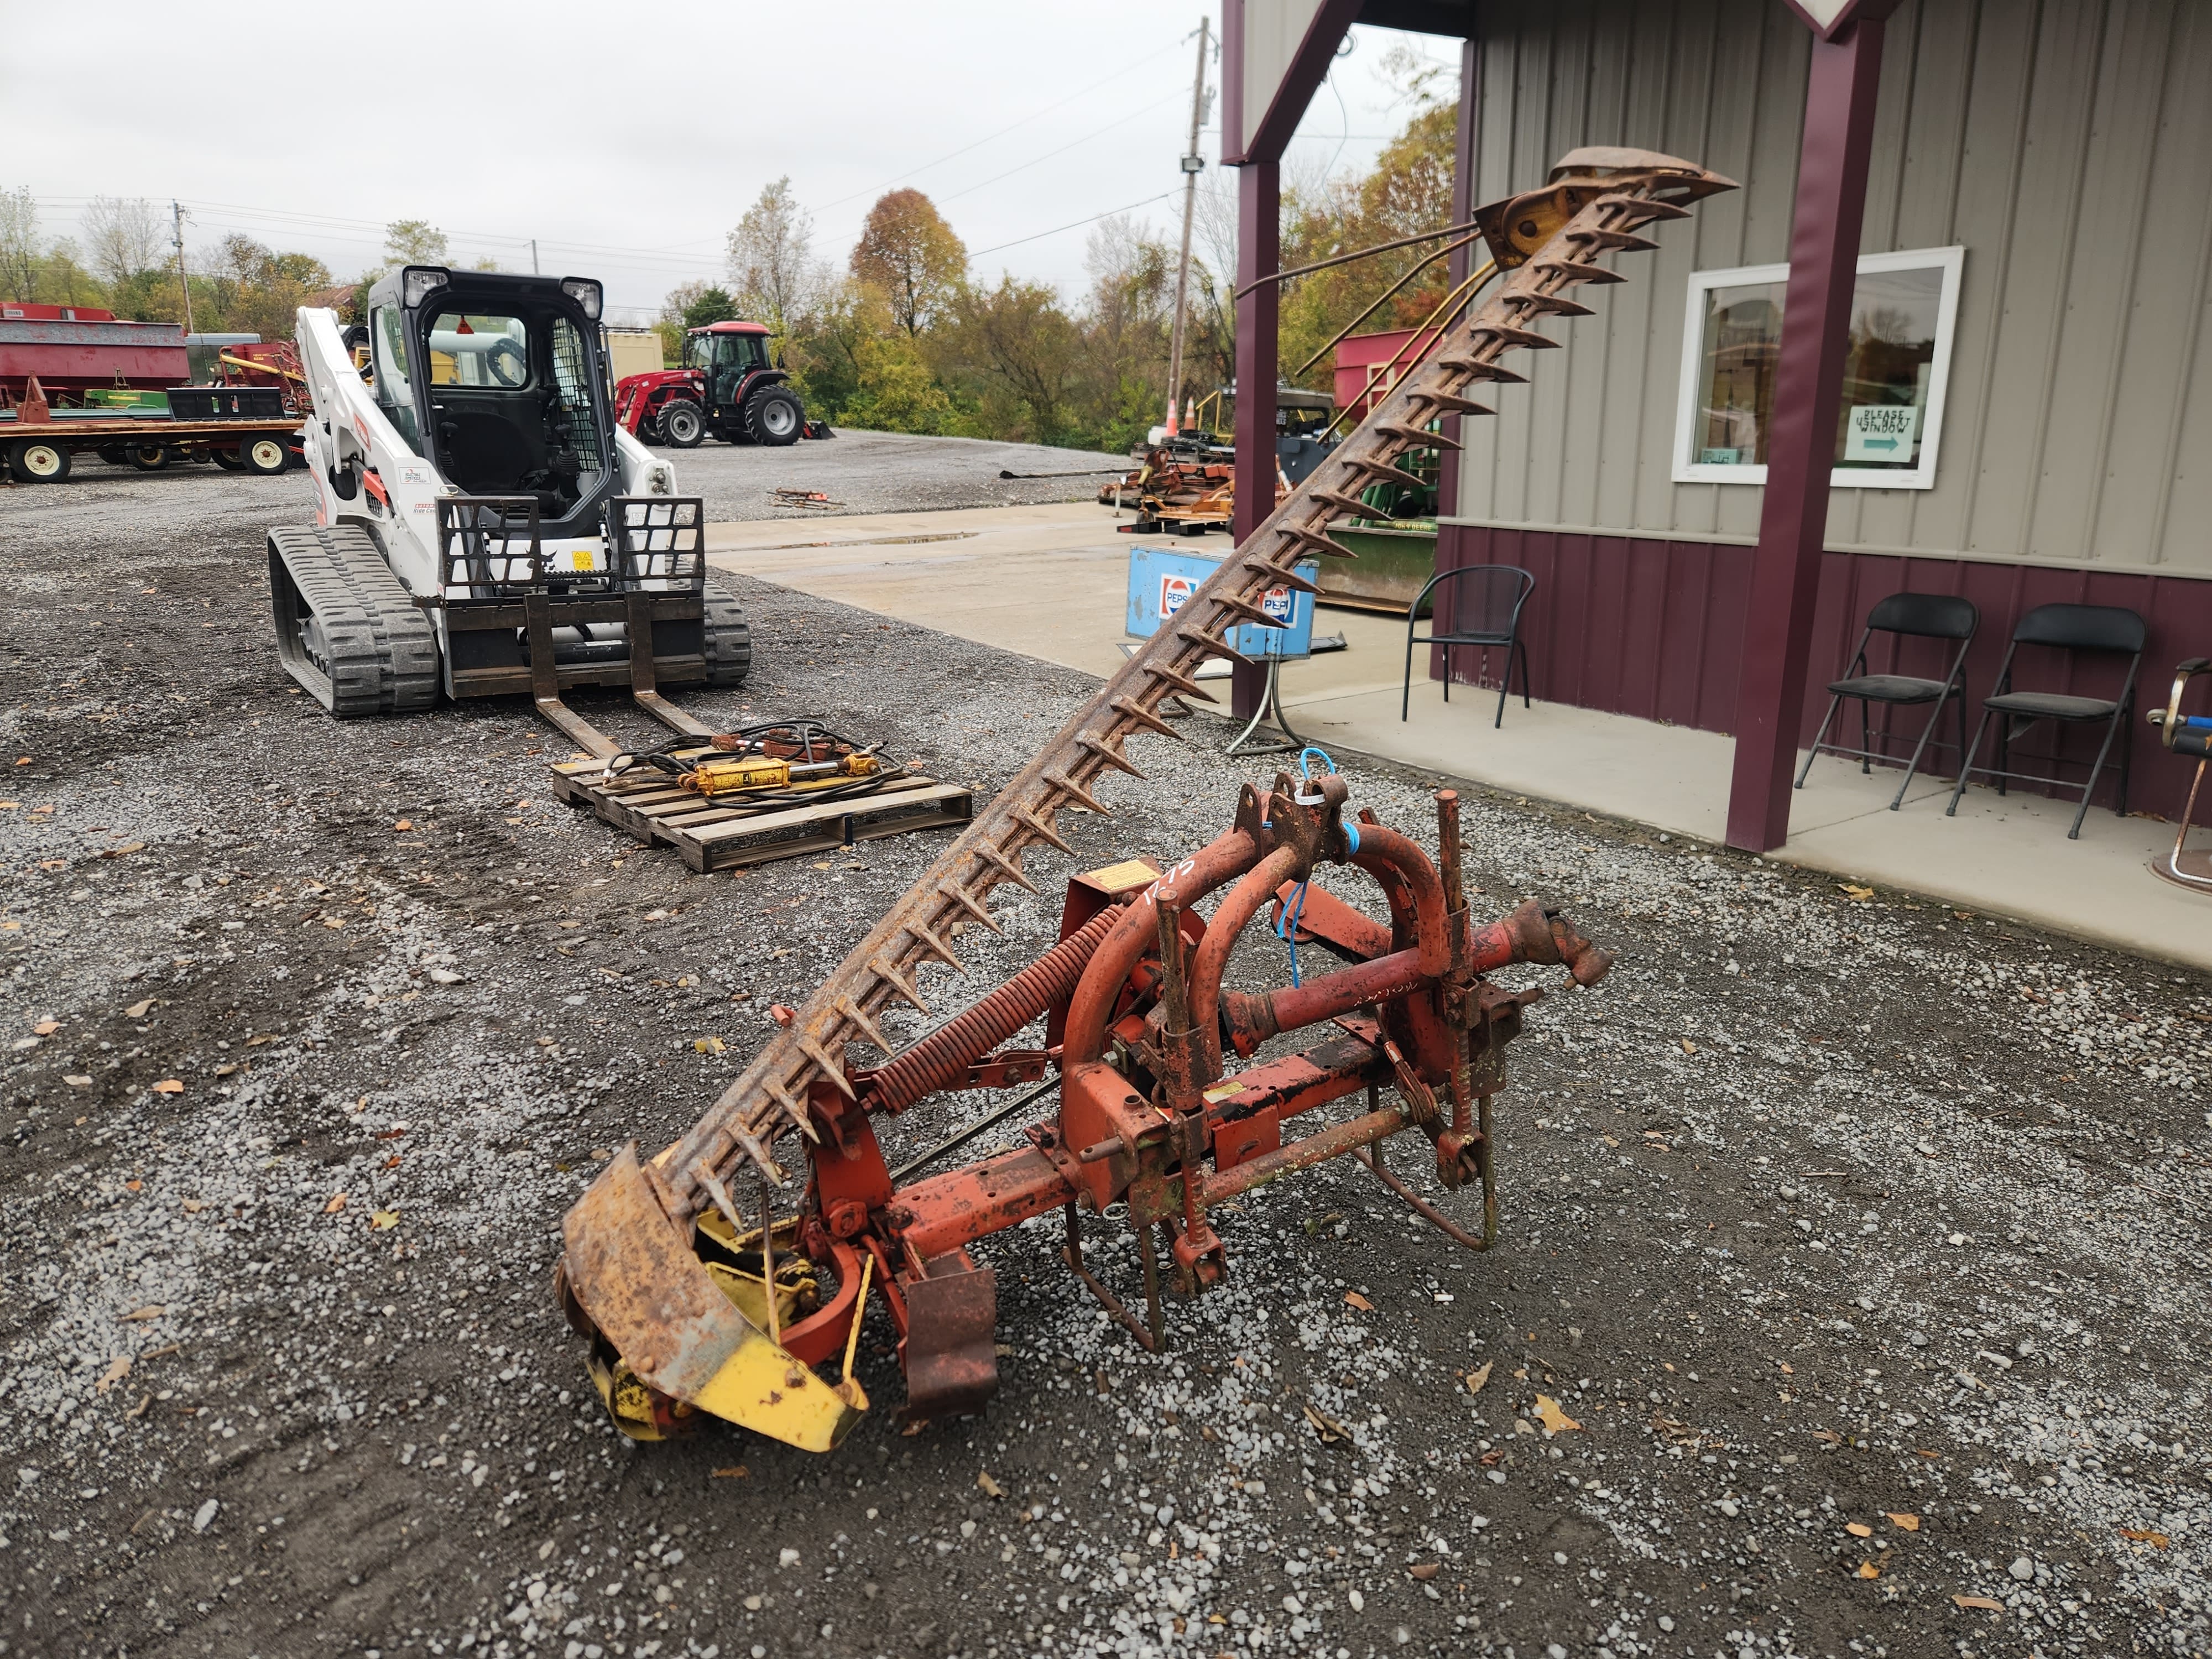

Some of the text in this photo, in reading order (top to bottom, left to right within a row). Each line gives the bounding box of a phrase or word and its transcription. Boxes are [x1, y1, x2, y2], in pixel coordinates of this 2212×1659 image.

[1864, 409, 1905, 419] PLEASE
[1860, 424, 1906, 434] WINDOW
[1167, 592, 1190, 604] PEPS
